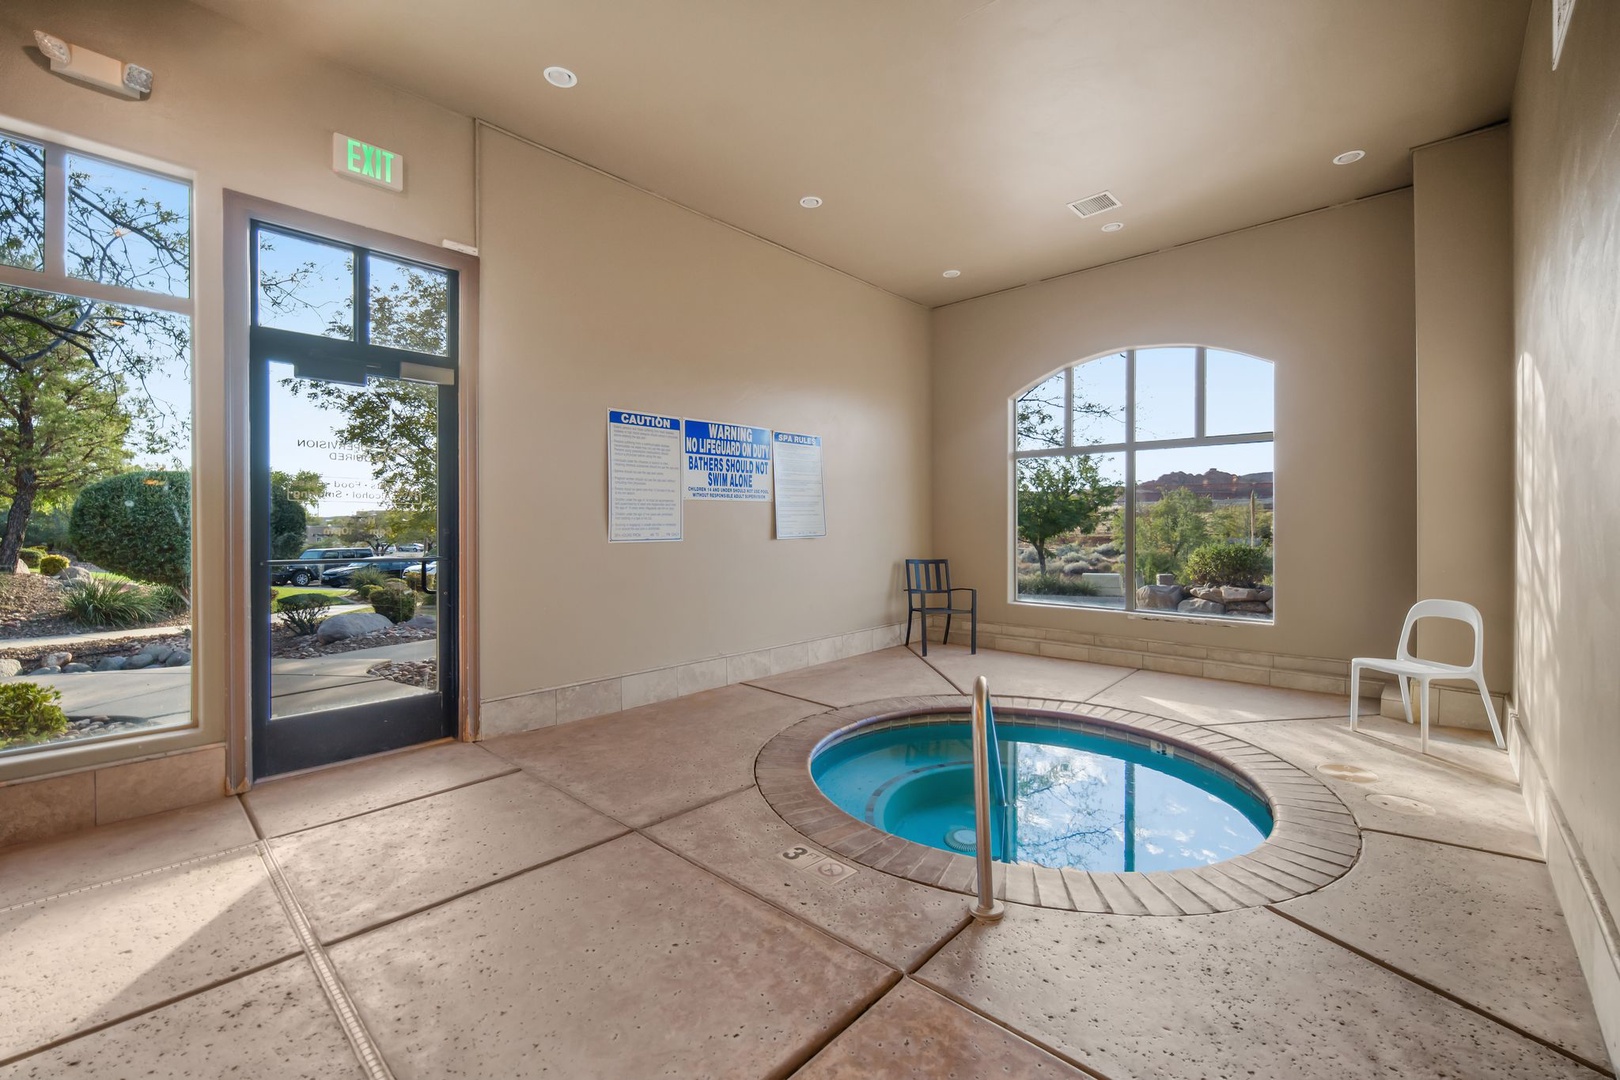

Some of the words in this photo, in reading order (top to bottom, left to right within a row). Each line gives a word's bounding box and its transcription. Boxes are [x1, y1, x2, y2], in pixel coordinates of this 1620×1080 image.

[347, 138, 394, 183] EXIT
[621, 413, 671, 429] CAUTION
[708, 423, 753, 443] WARNING
[778, 434, 793, 443] SPA
[794, 436, 816, 445] RULES
[686, 436, 698, 452] NO
[699, 438, 741, 456] LIFEGUARD
[742, 442, 752, 457] ON
[752, 444, 769, 458] DUTY
[688, 455, 724, 472] BATHERS
[725, 458, 754, 474] SHOULD
[755, 460, 769, 475] NOT
[707, 472, 728, 487] SWIM
[730, 473, 753, 488] ALONE
[782, 847, 808, 860] 3
